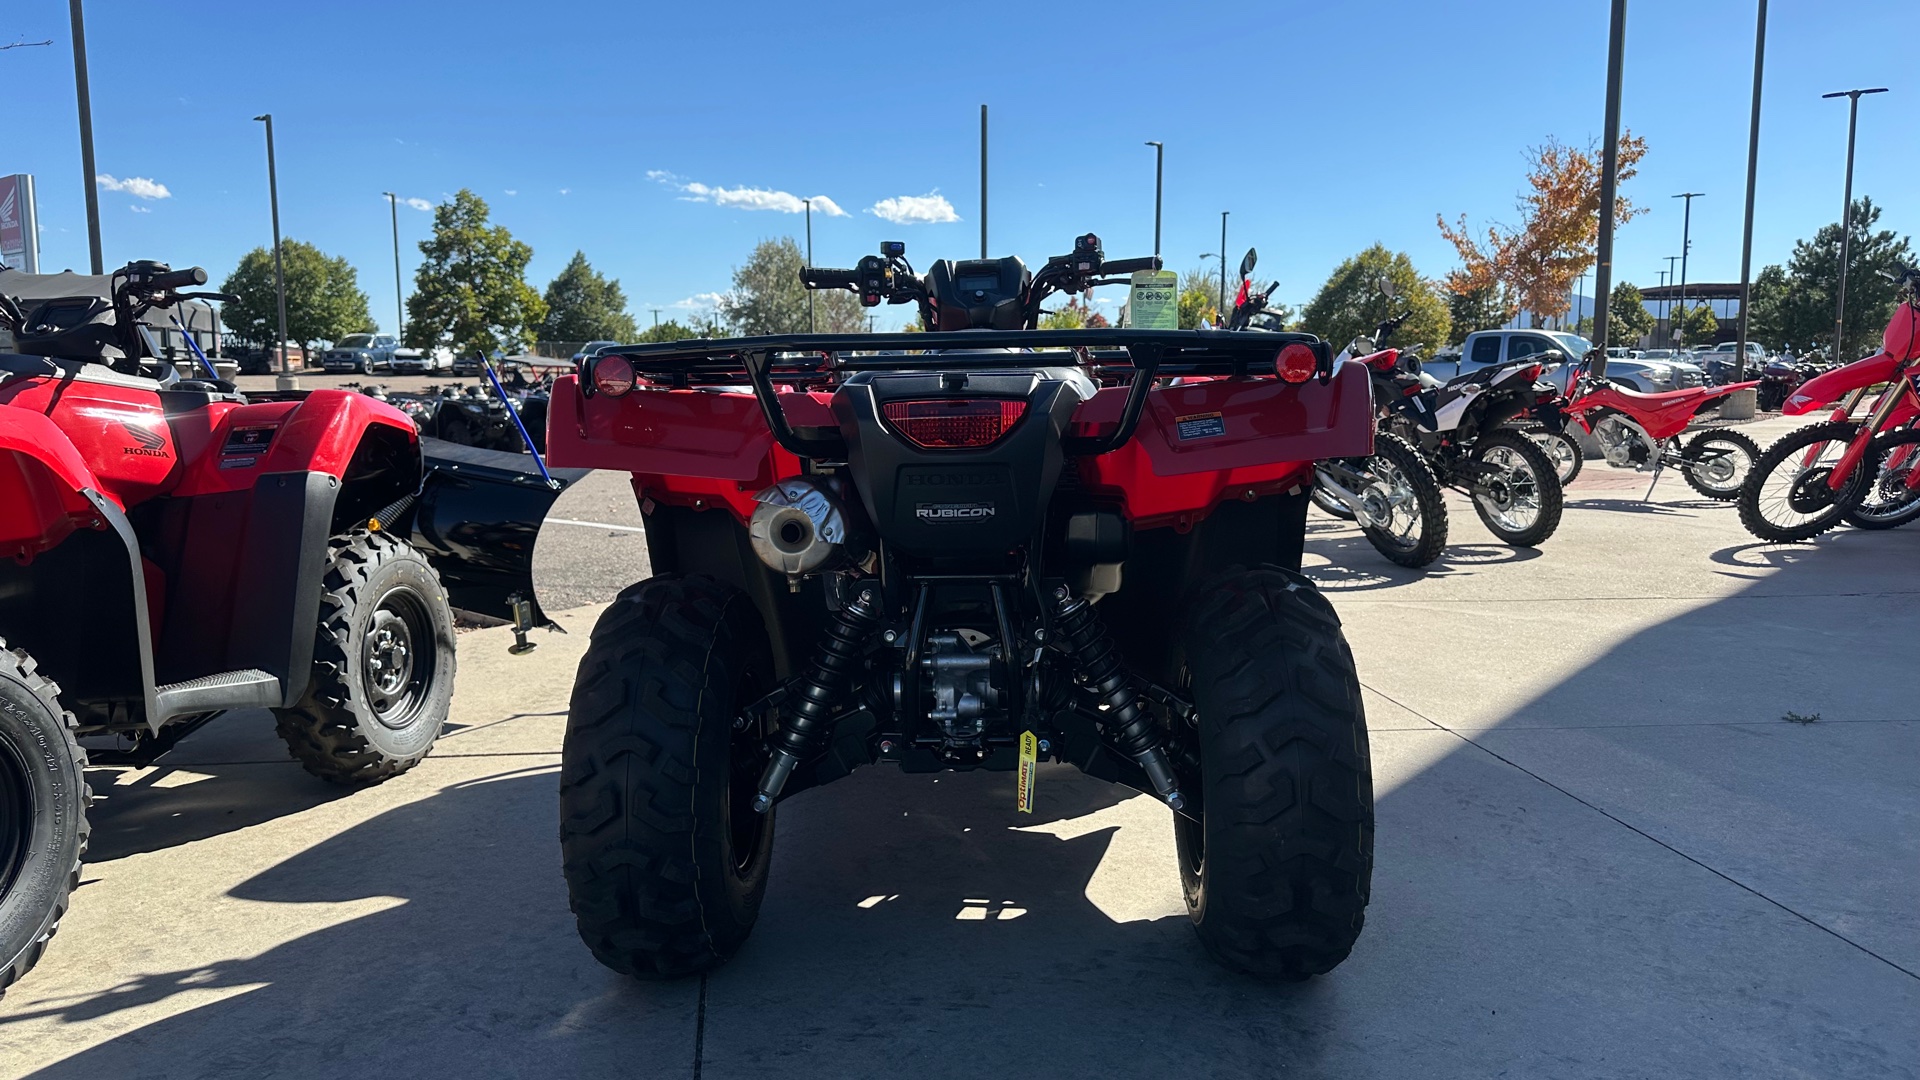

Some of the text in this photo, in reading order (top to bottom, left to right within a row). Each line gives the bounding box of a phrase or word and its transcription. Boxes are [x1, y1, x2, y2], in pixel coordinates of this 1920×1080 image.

[1447, 381, 1467, 392] HON
[1661, 397, 1686, 407] HONDA
[123, 447, 170, 459] HONDA
[905, 474, 1006, 487] HONDA
[916, 507, 996, 518] RUBICON
